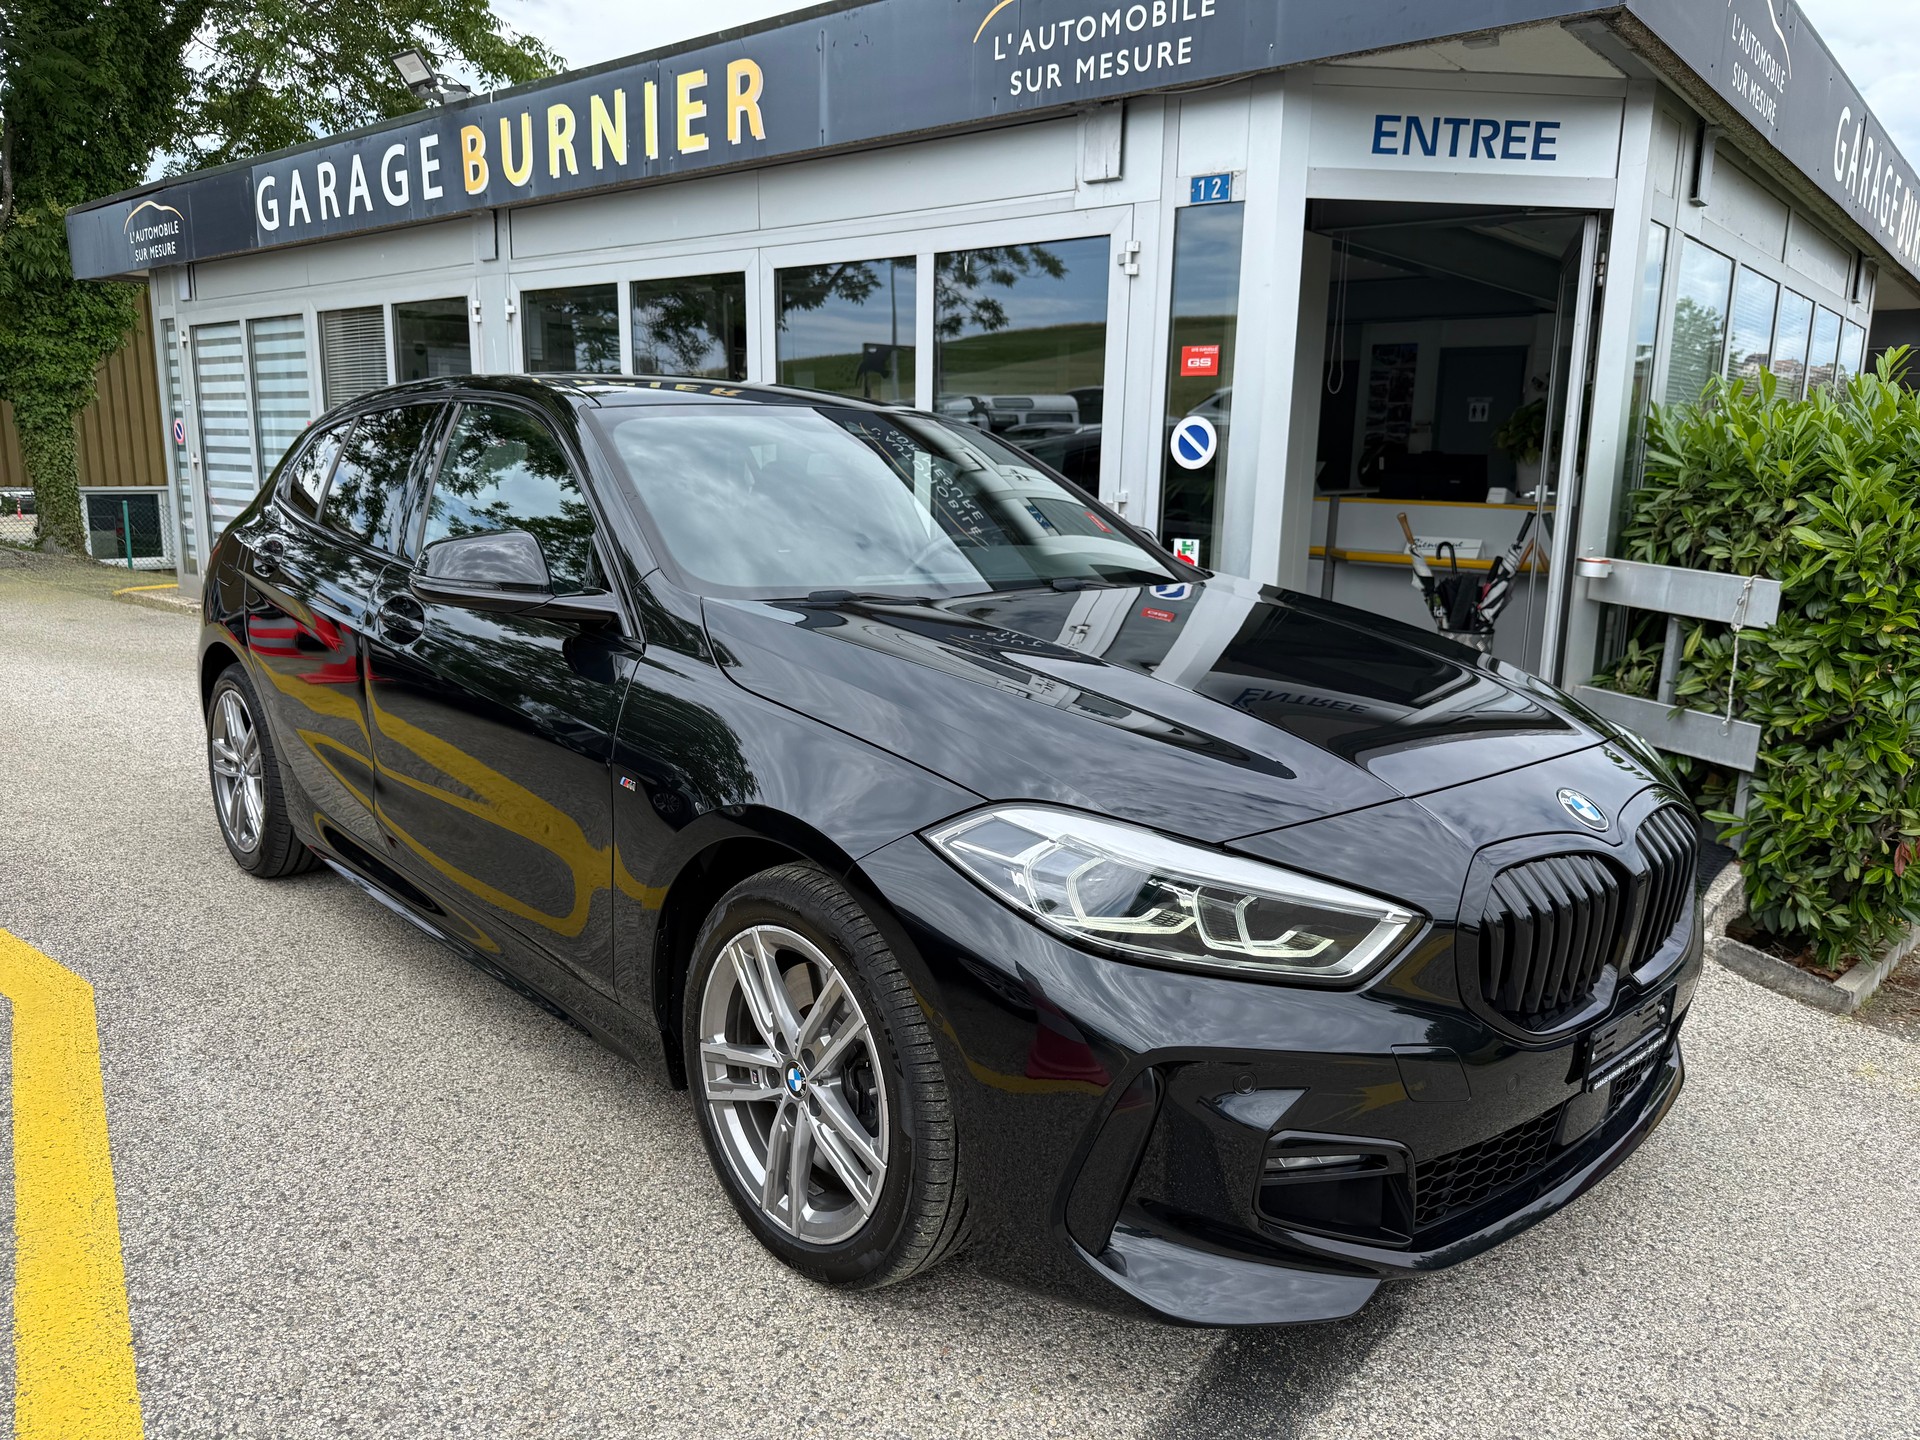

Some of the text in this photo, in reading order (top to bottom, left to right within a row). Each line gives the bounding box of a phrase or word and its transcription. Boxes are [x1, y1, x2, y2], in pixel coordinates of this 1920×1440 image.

[994, 0, 1216, 61] L'AUTOMOBILE
[1731, 13, 1786, 94] L'AUTOMOBILE
[1010, 36, 1192, 96] SUR MESURE
[1732, 61, 1777, 127] SUR MESURE
[256, 57, 767, 231] GARAGE BURNIER
[1371, 114, 1561, 161] ENTREE
[1198, 177, 1222, 200] 12
[1833, 106, 1902, 238] GARAGE
[129, 220, 179, 244] L'AUTOMOBILE
[135, 241, 177, 262] SUR MESURE
